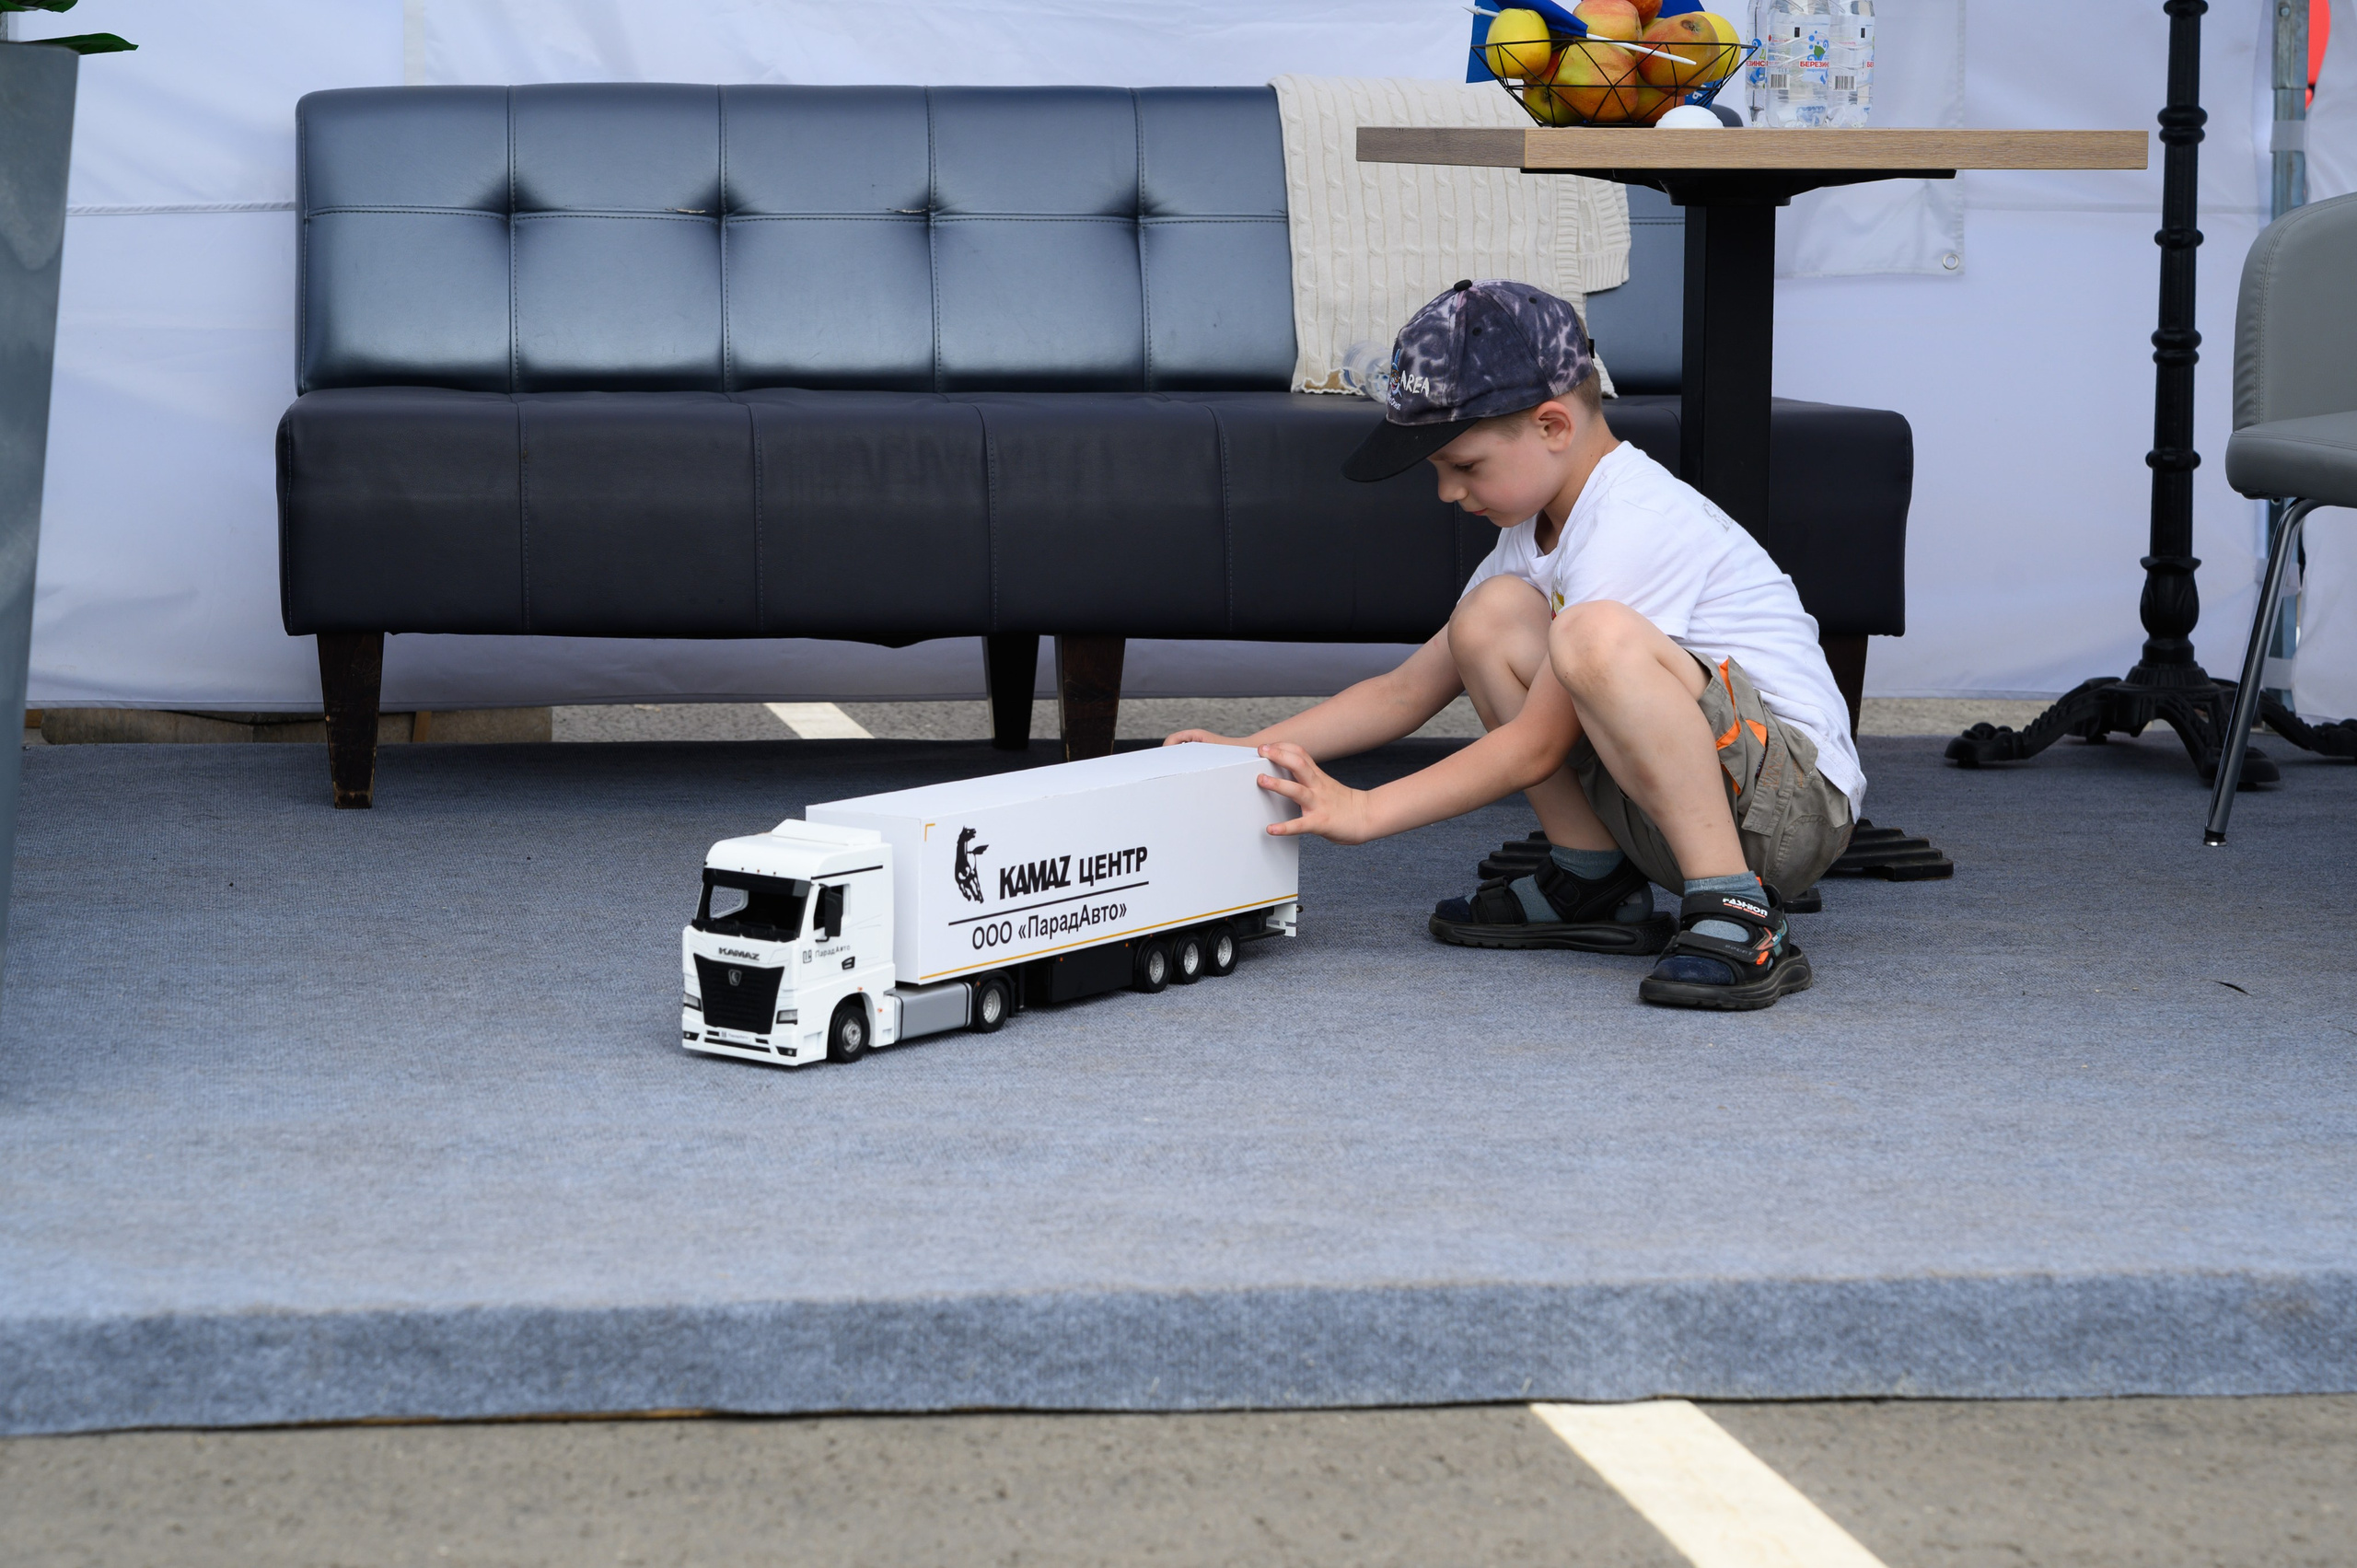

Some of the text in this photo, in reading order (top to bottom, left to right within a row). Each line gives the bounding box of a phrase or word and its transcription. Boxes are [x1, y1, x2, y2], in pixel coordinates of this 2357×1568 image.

[1400, 370, 1430, 398] AREA
[999, 846, 1148, 900] KAMAZ ЦЕНТР
[972, 902, 1127, 950] ООО «ПарадАвто»
[718, 947, 761, 961] KAMAZ
